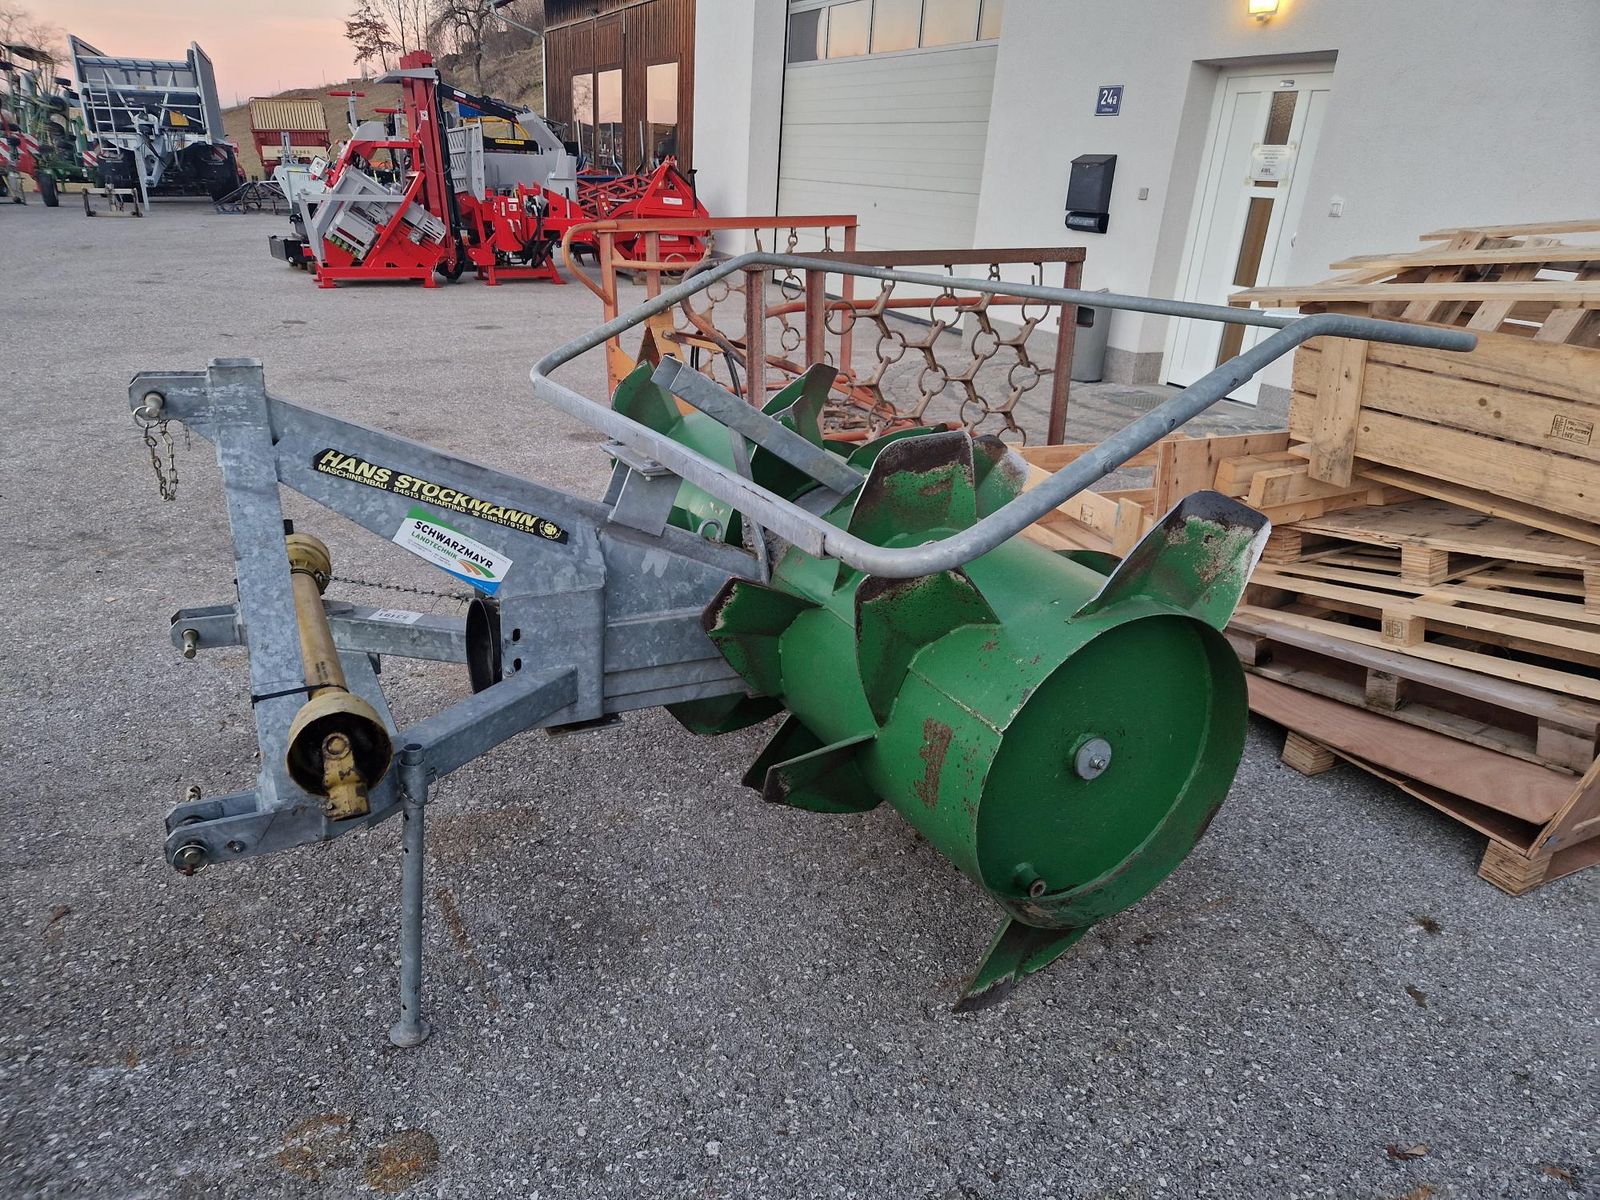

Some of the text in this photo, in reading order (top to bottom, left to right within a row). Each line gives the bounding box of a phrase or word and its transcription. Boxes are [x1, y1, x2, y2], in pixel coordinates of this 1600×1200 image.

[1100, 89, 1117, 105] 24a
[318, 464, 387, 489] MASCHINENBAU
[393, 486, 419, 499] 84513
[420, 494, 466, 513] ERHARTING
[320, 450, 539, 527] HANS STOCKMANN
[411, 531, 458, 560] LANDTECHNIK
[414, 520, 494, 569] SCHWARZMAYR
